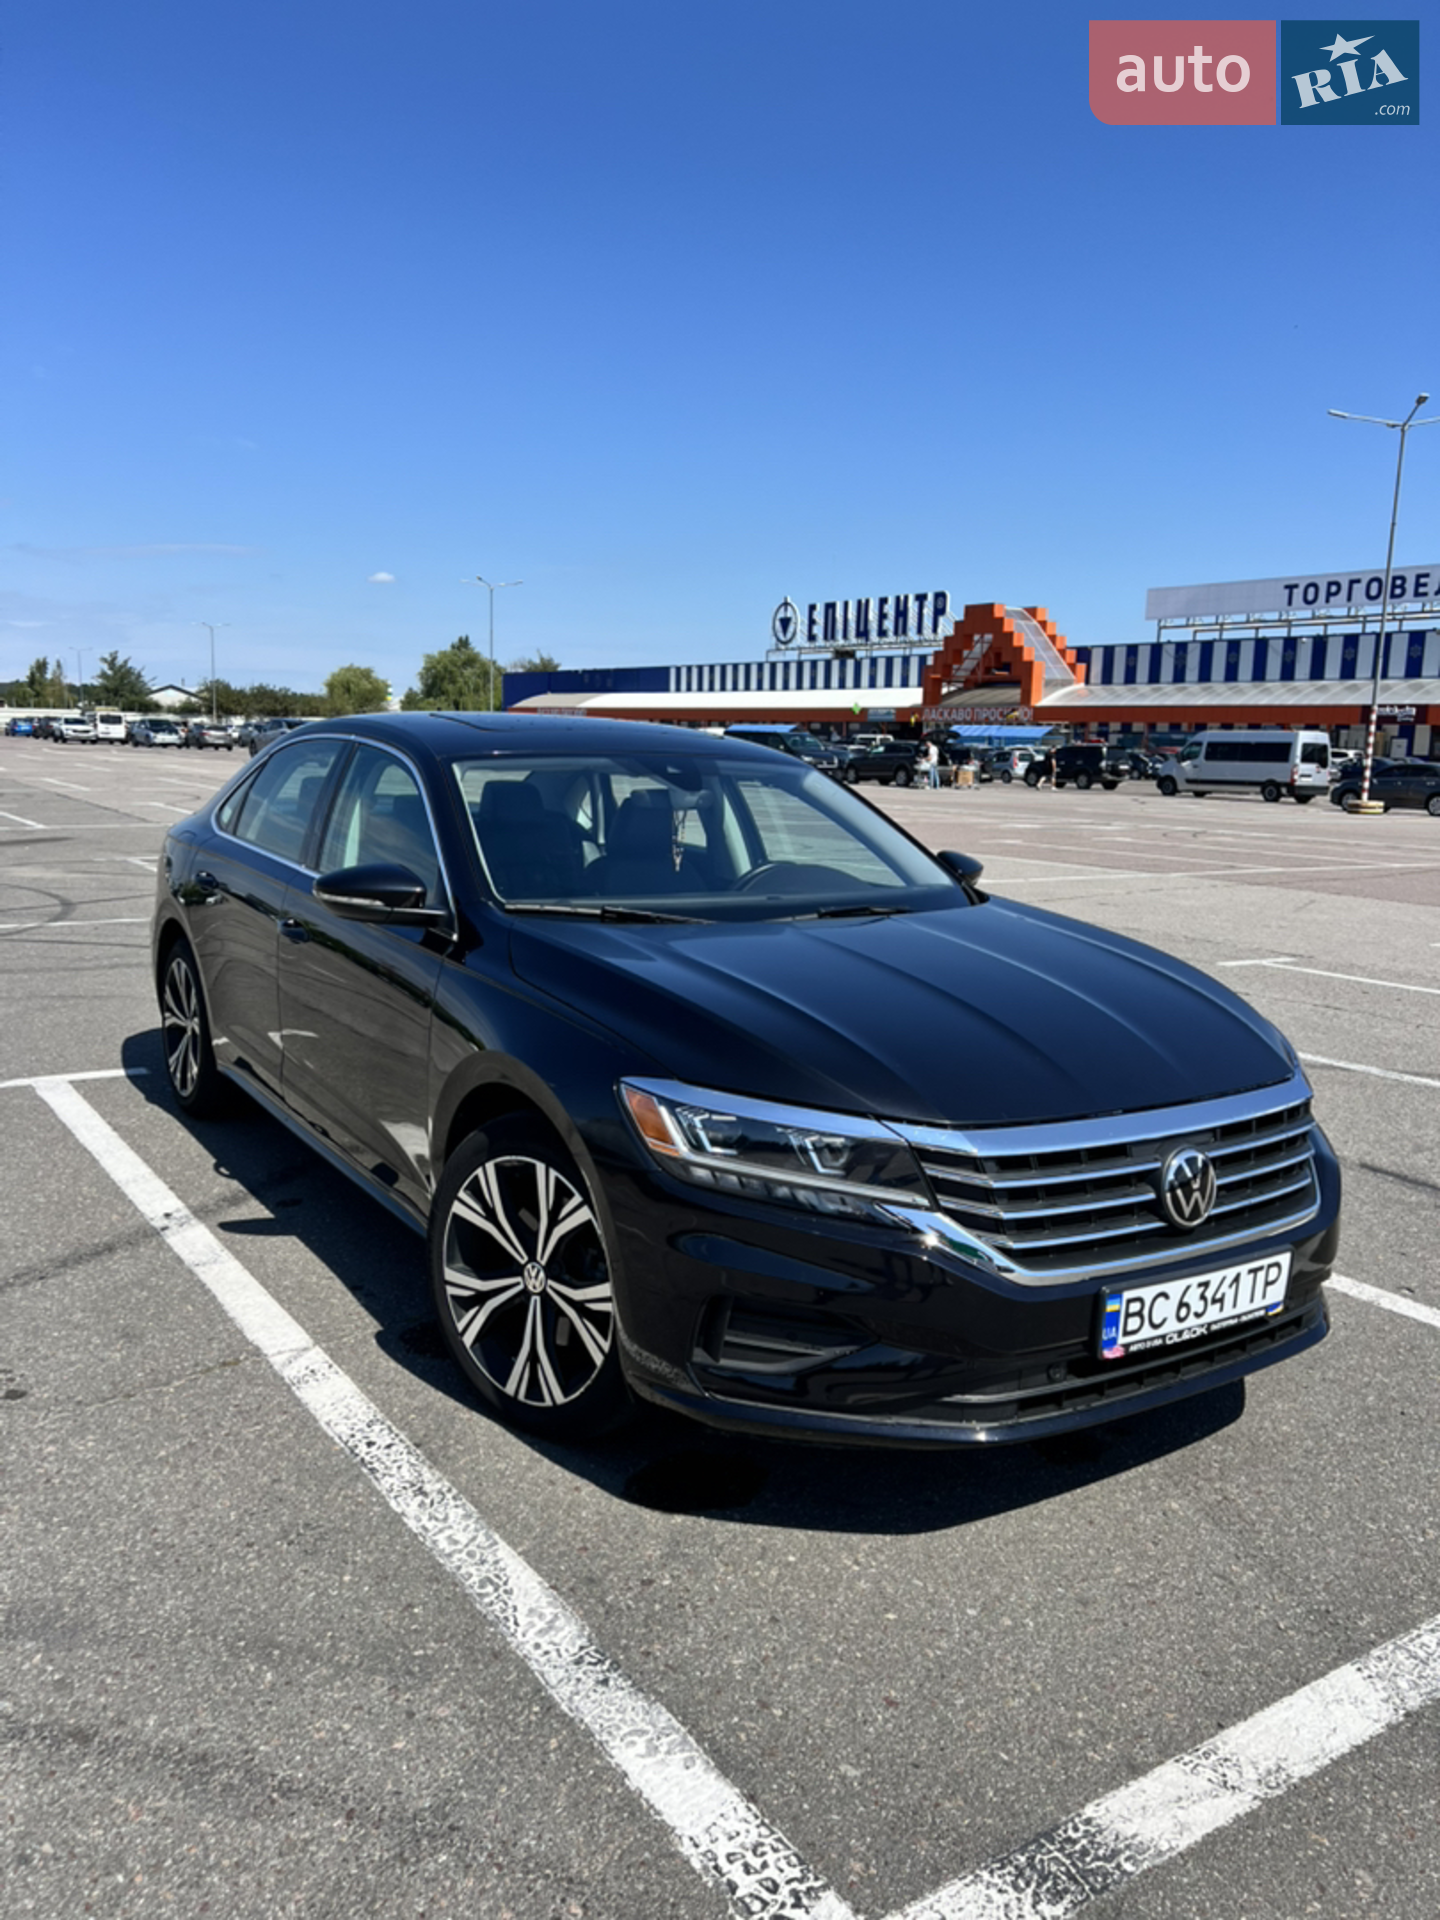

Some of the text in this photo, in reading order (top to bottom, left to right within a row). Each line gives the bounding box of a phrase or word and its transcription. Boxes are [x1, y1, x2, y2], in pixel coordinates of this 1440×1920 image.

[807, 590, 949, 642] ЕПІЦЕНТР
[922, 706, 972, 722] ЛАСКАВО
[1175, 1272, 1242, 1324] 6341
